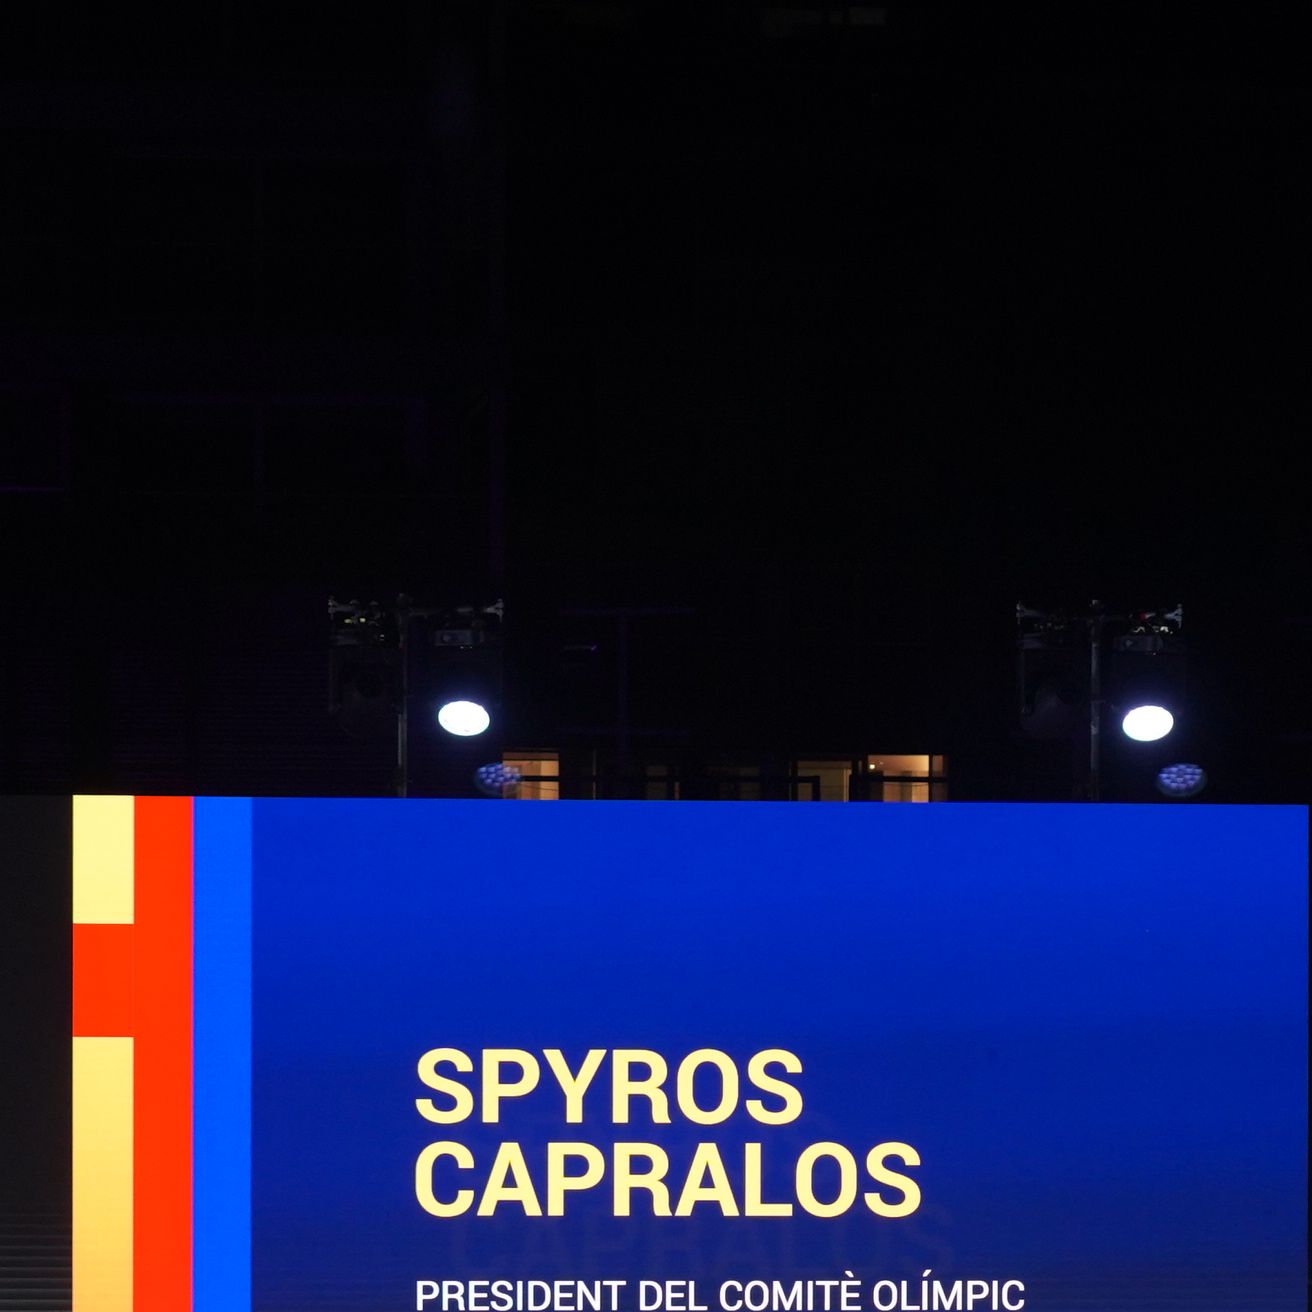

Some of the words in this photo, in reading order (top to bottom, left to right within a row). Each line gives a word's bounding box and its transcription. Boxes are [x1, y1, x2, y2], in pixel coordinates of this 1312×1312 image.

[415, 1047, 804, 1125] SPYROS
[415, 1141, 922, 1218] CAPRALOS
[416, 1280, 626, 1312] PRESIDENT
[639, 1280, 708, 1312] DEL
[719, 1271, 861, 1312] COMITÈ
[872, 1270, 1025, 1312] OLÍMPIC
